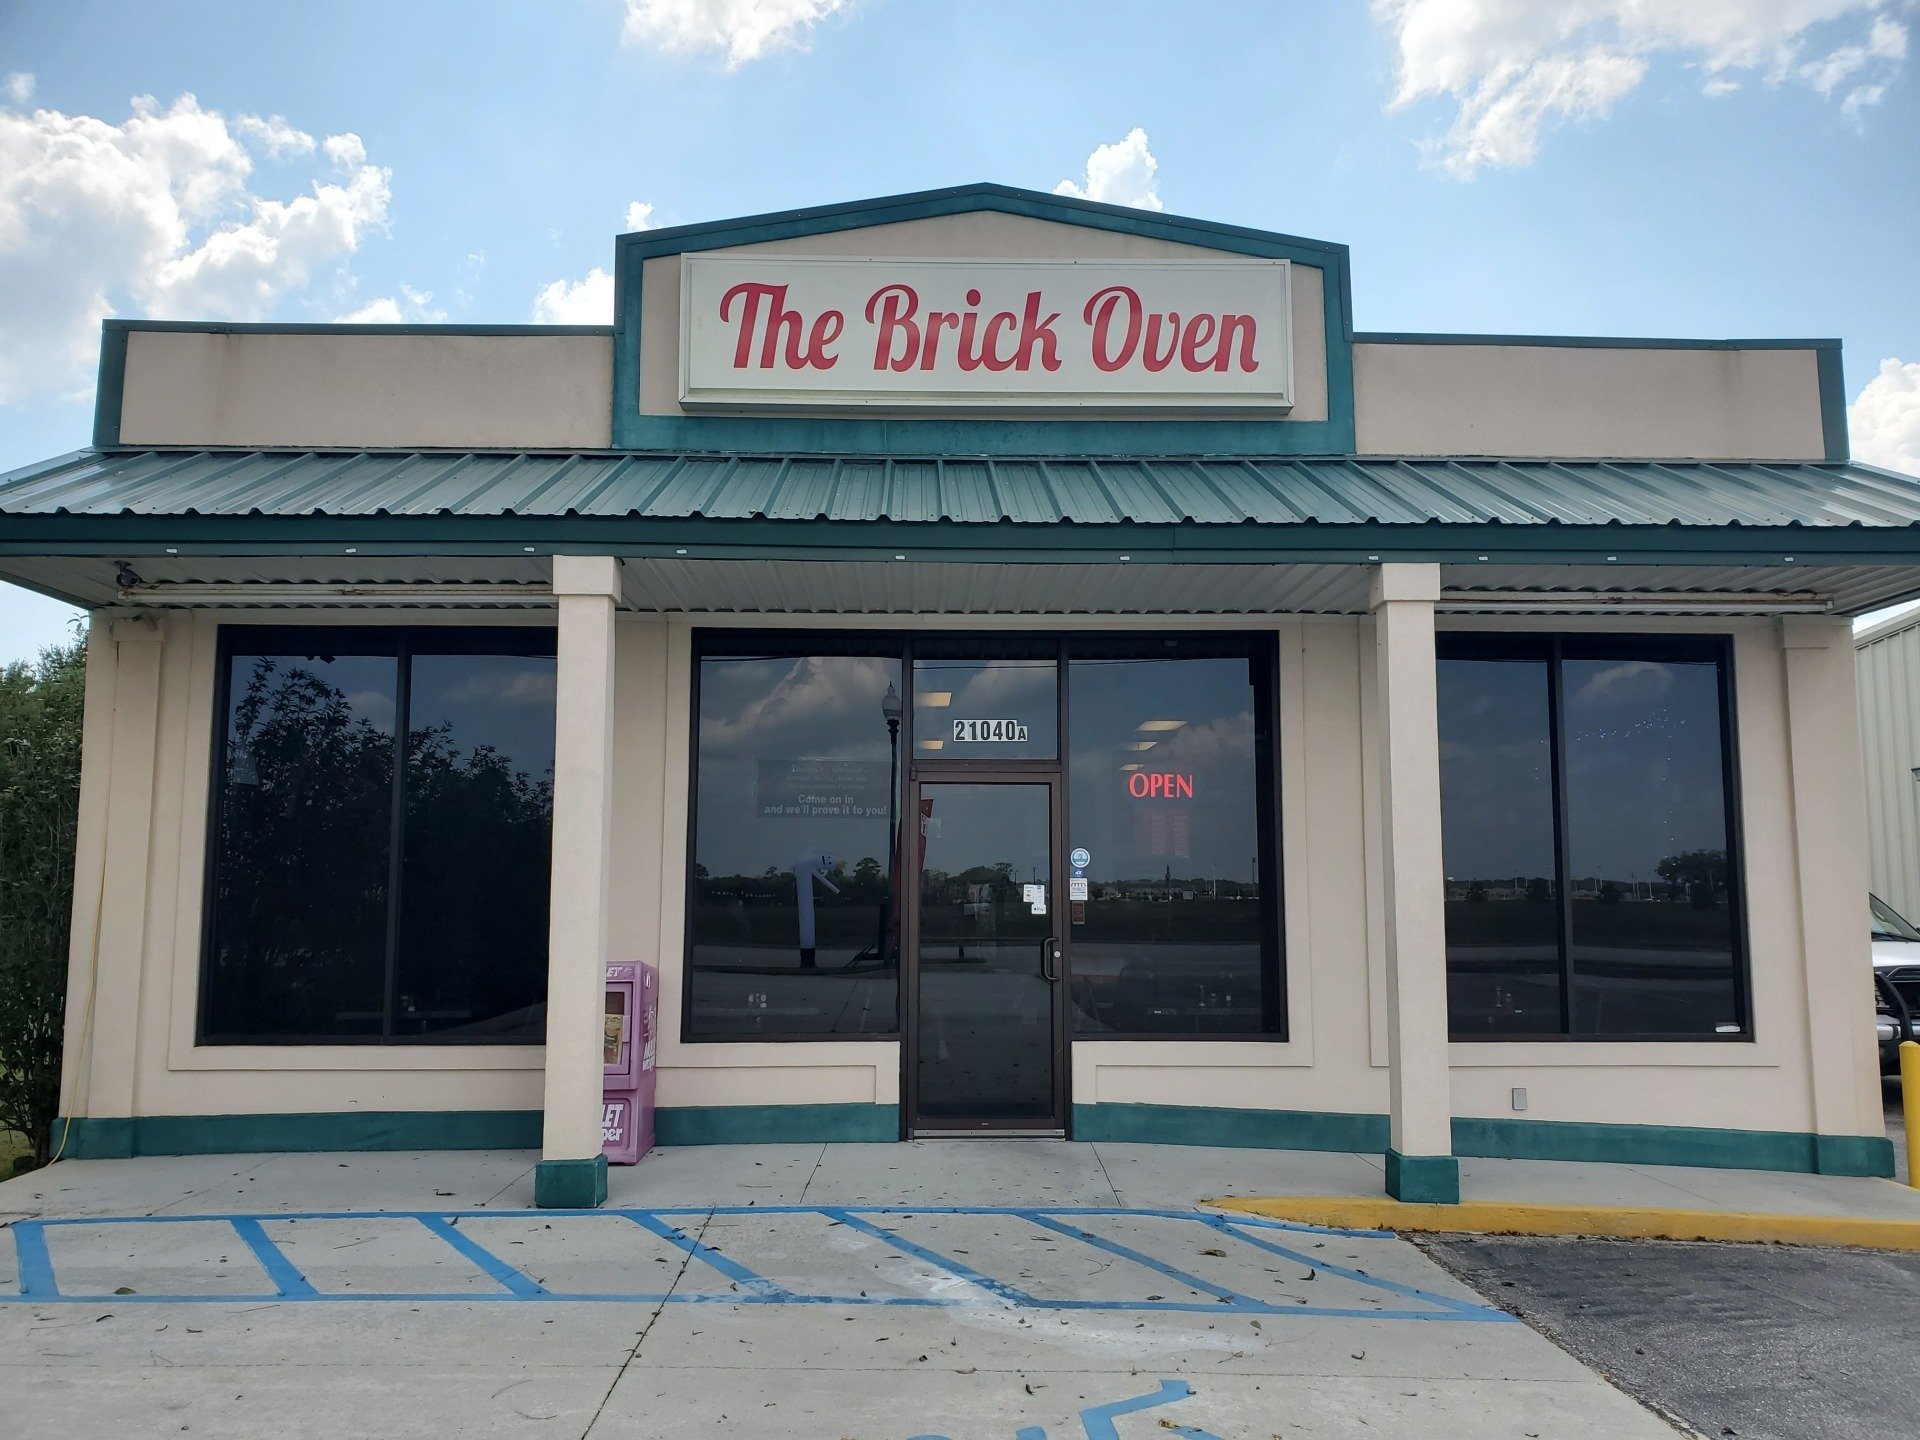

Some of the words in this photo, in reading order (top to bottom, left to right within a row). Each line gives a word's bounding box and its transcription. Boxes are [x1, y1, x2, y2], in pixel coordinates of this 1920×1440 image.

[719, 282, 844, 369] The
[865, 283, 1062, 372] Brick
[1083, 285, 1260, 373] Oven
[1128, 772, 1193, 799] OPEN
[798, 794, 827, 804] Come
[829, 796, 842, 804] on
[844, 794, 854, 804] in
[763, 804, 783, 814] and
[786, 804, 810, 814] we'll
[812, 805, 841, 817] prove
[842, 804, 850, 814] it
[852, 805, 863, 815] to
[865, 805, 887, 817] you!
